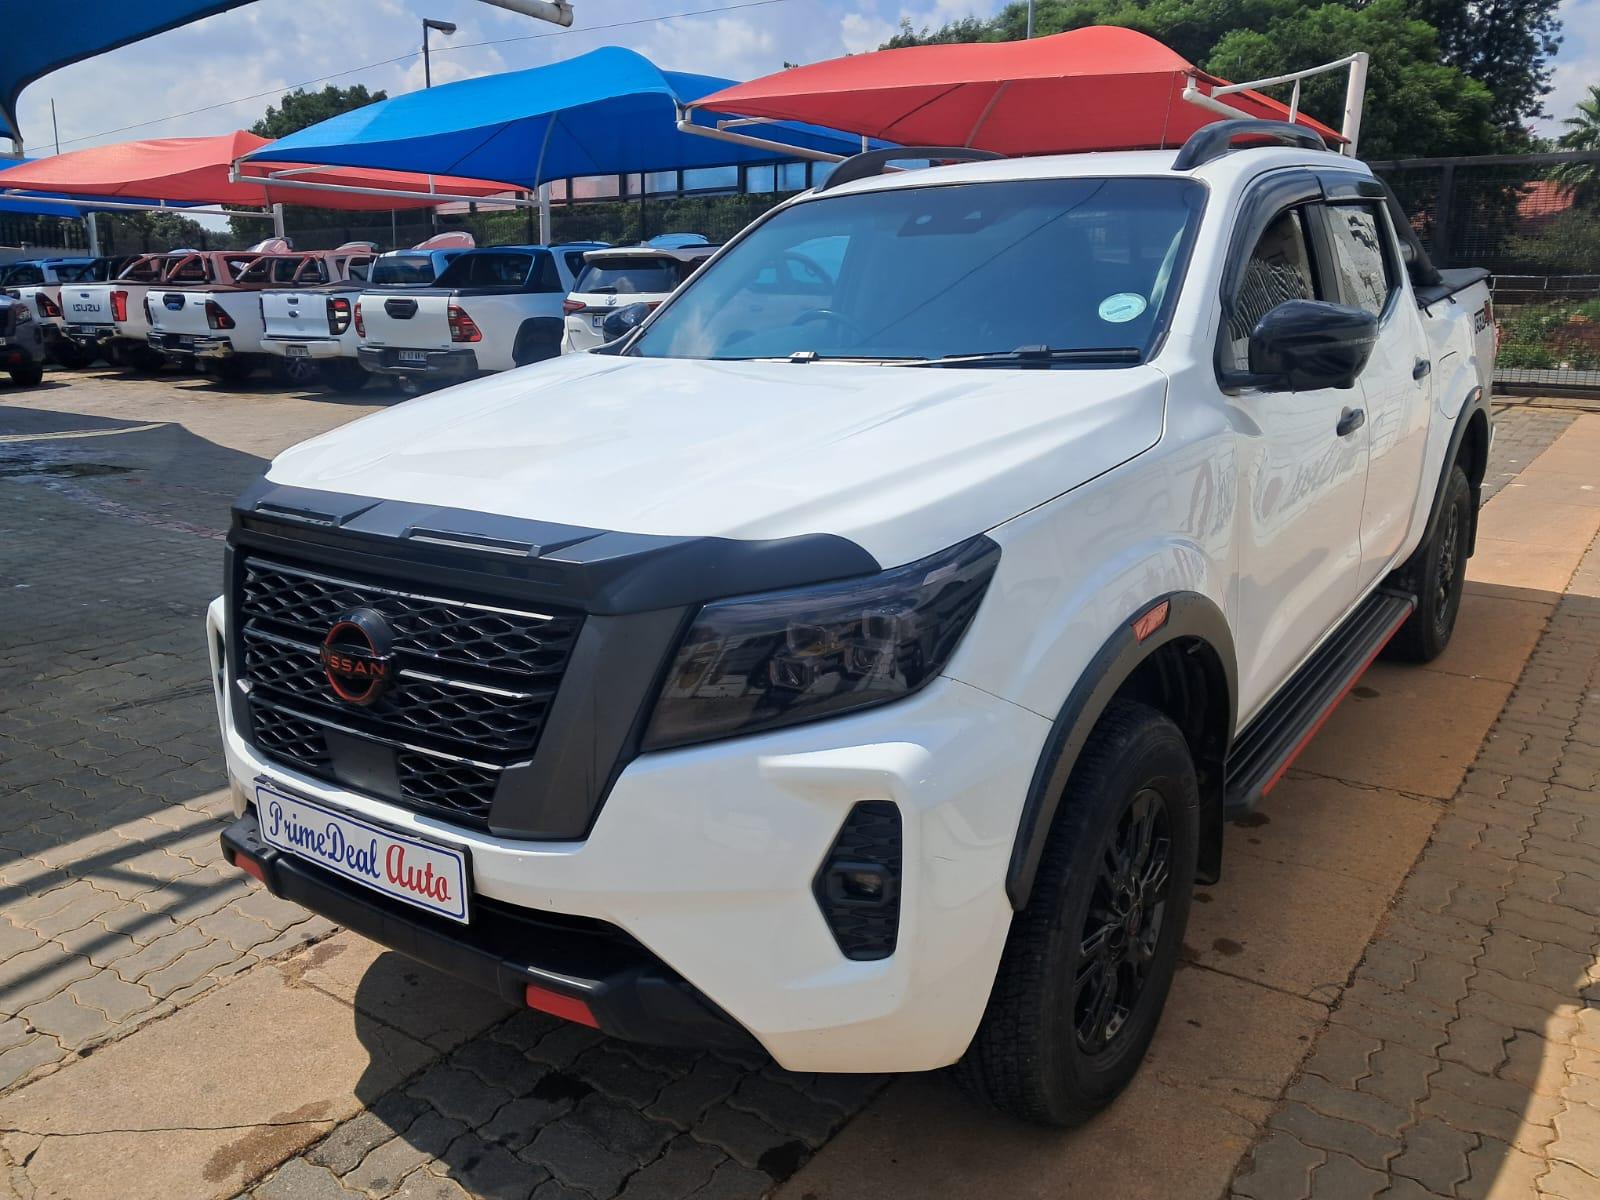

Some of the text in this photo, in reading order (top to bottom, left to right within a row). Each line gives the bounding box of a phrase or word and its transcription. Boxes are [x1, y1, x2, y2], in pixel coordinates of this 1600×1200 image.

[72, 303, 101, 312] ISUZU
[322, 650, 386, 677] SSAN
[269, 801, 452, 902] PrimeDeal Auto
